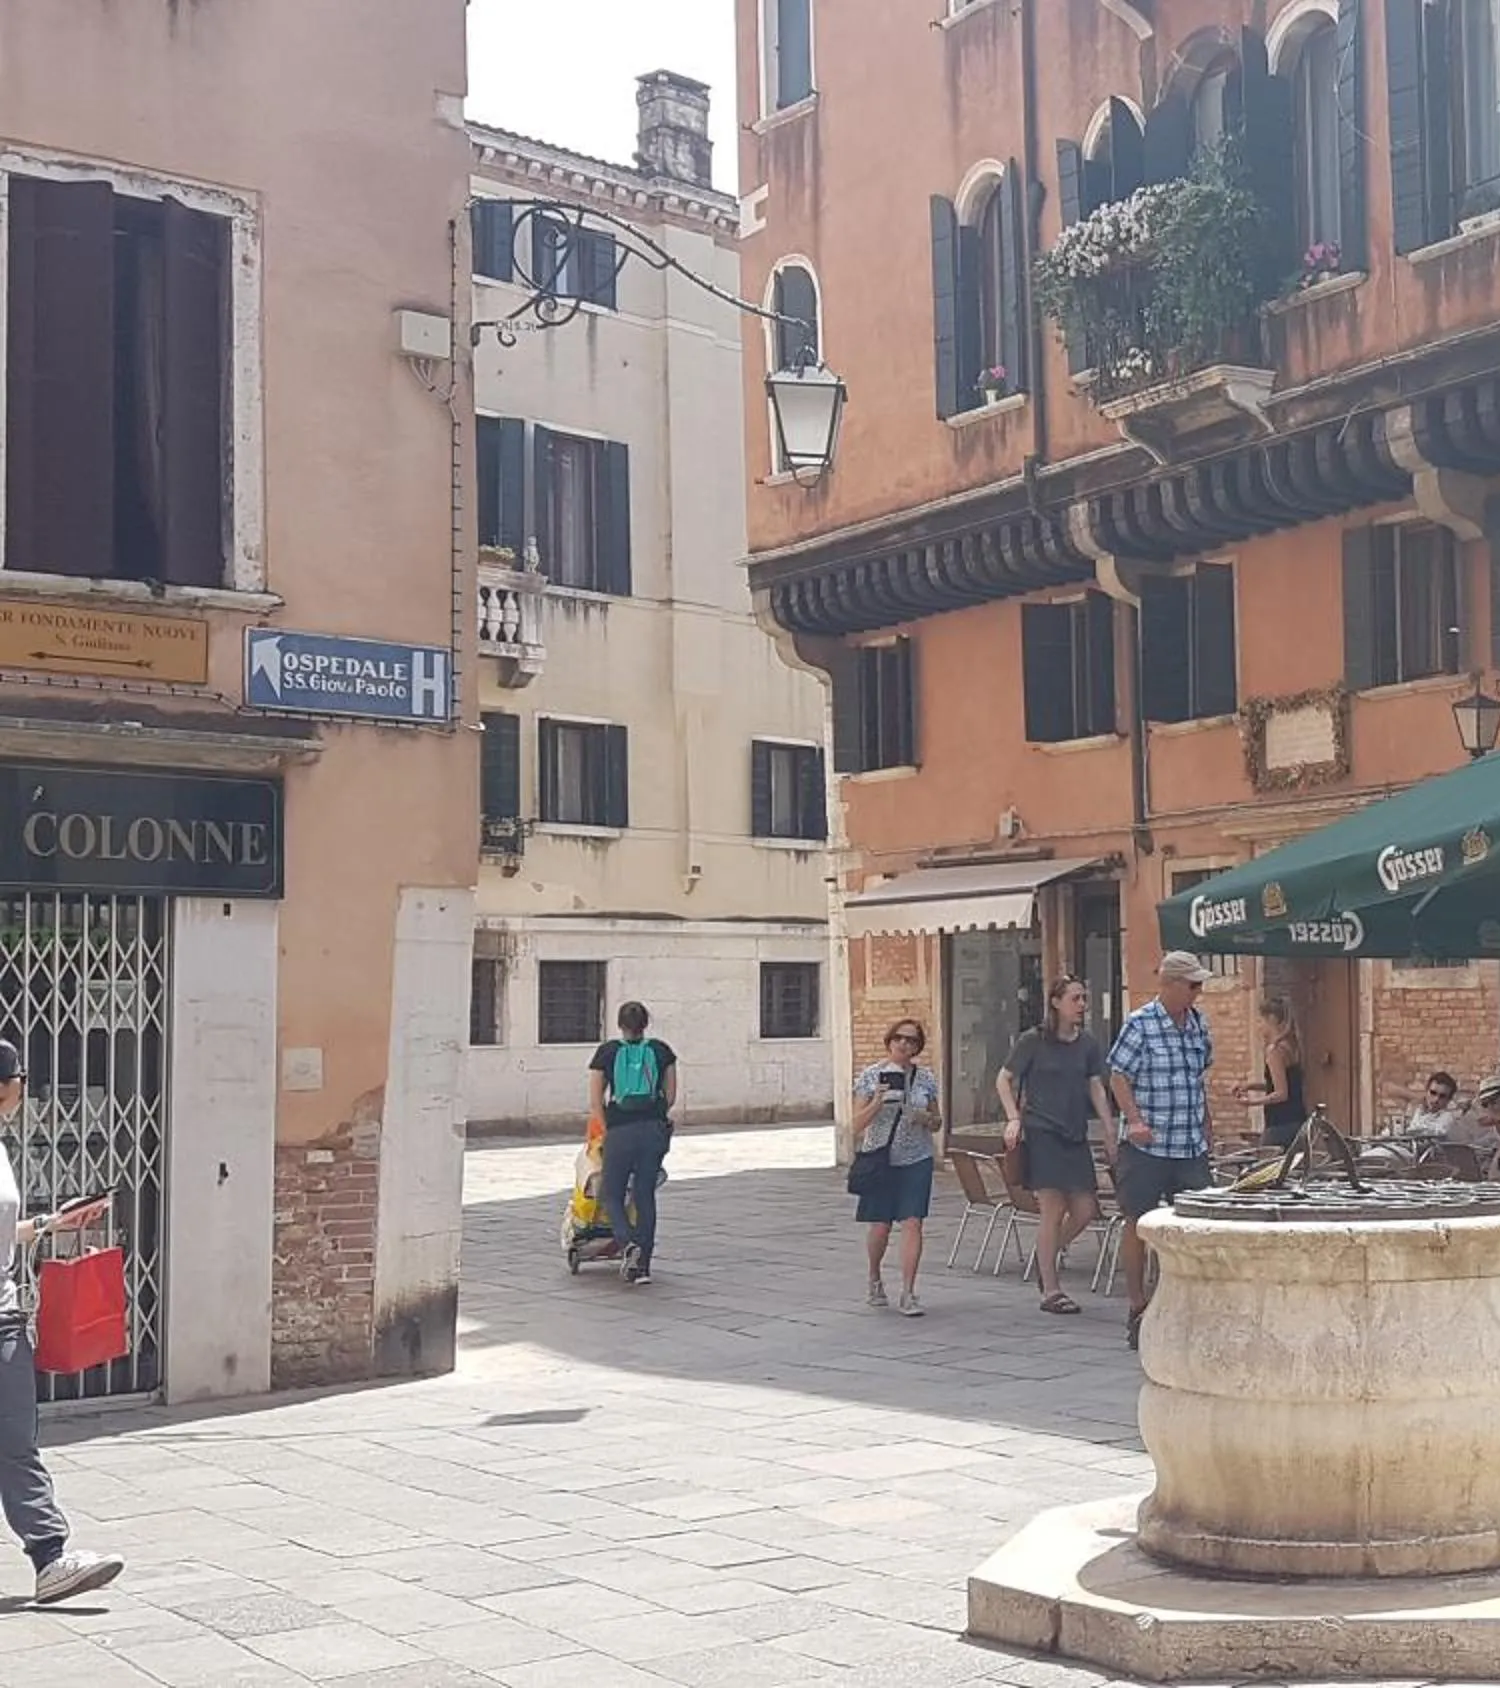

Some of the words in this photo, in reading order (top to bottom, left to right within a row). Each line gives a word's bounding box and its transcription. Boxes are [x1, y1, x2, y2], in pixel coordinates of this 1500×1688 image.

[283, 652, 408, 681] OSPEDALE
[355, 678, 408, 698] Paolo
[411, 651, 446, 717] H
[23, 811, 268, 866] COLONNE
[1377, 844, 1445, 891] Gösser
[1189, 895, 1247, 938] Gösser
